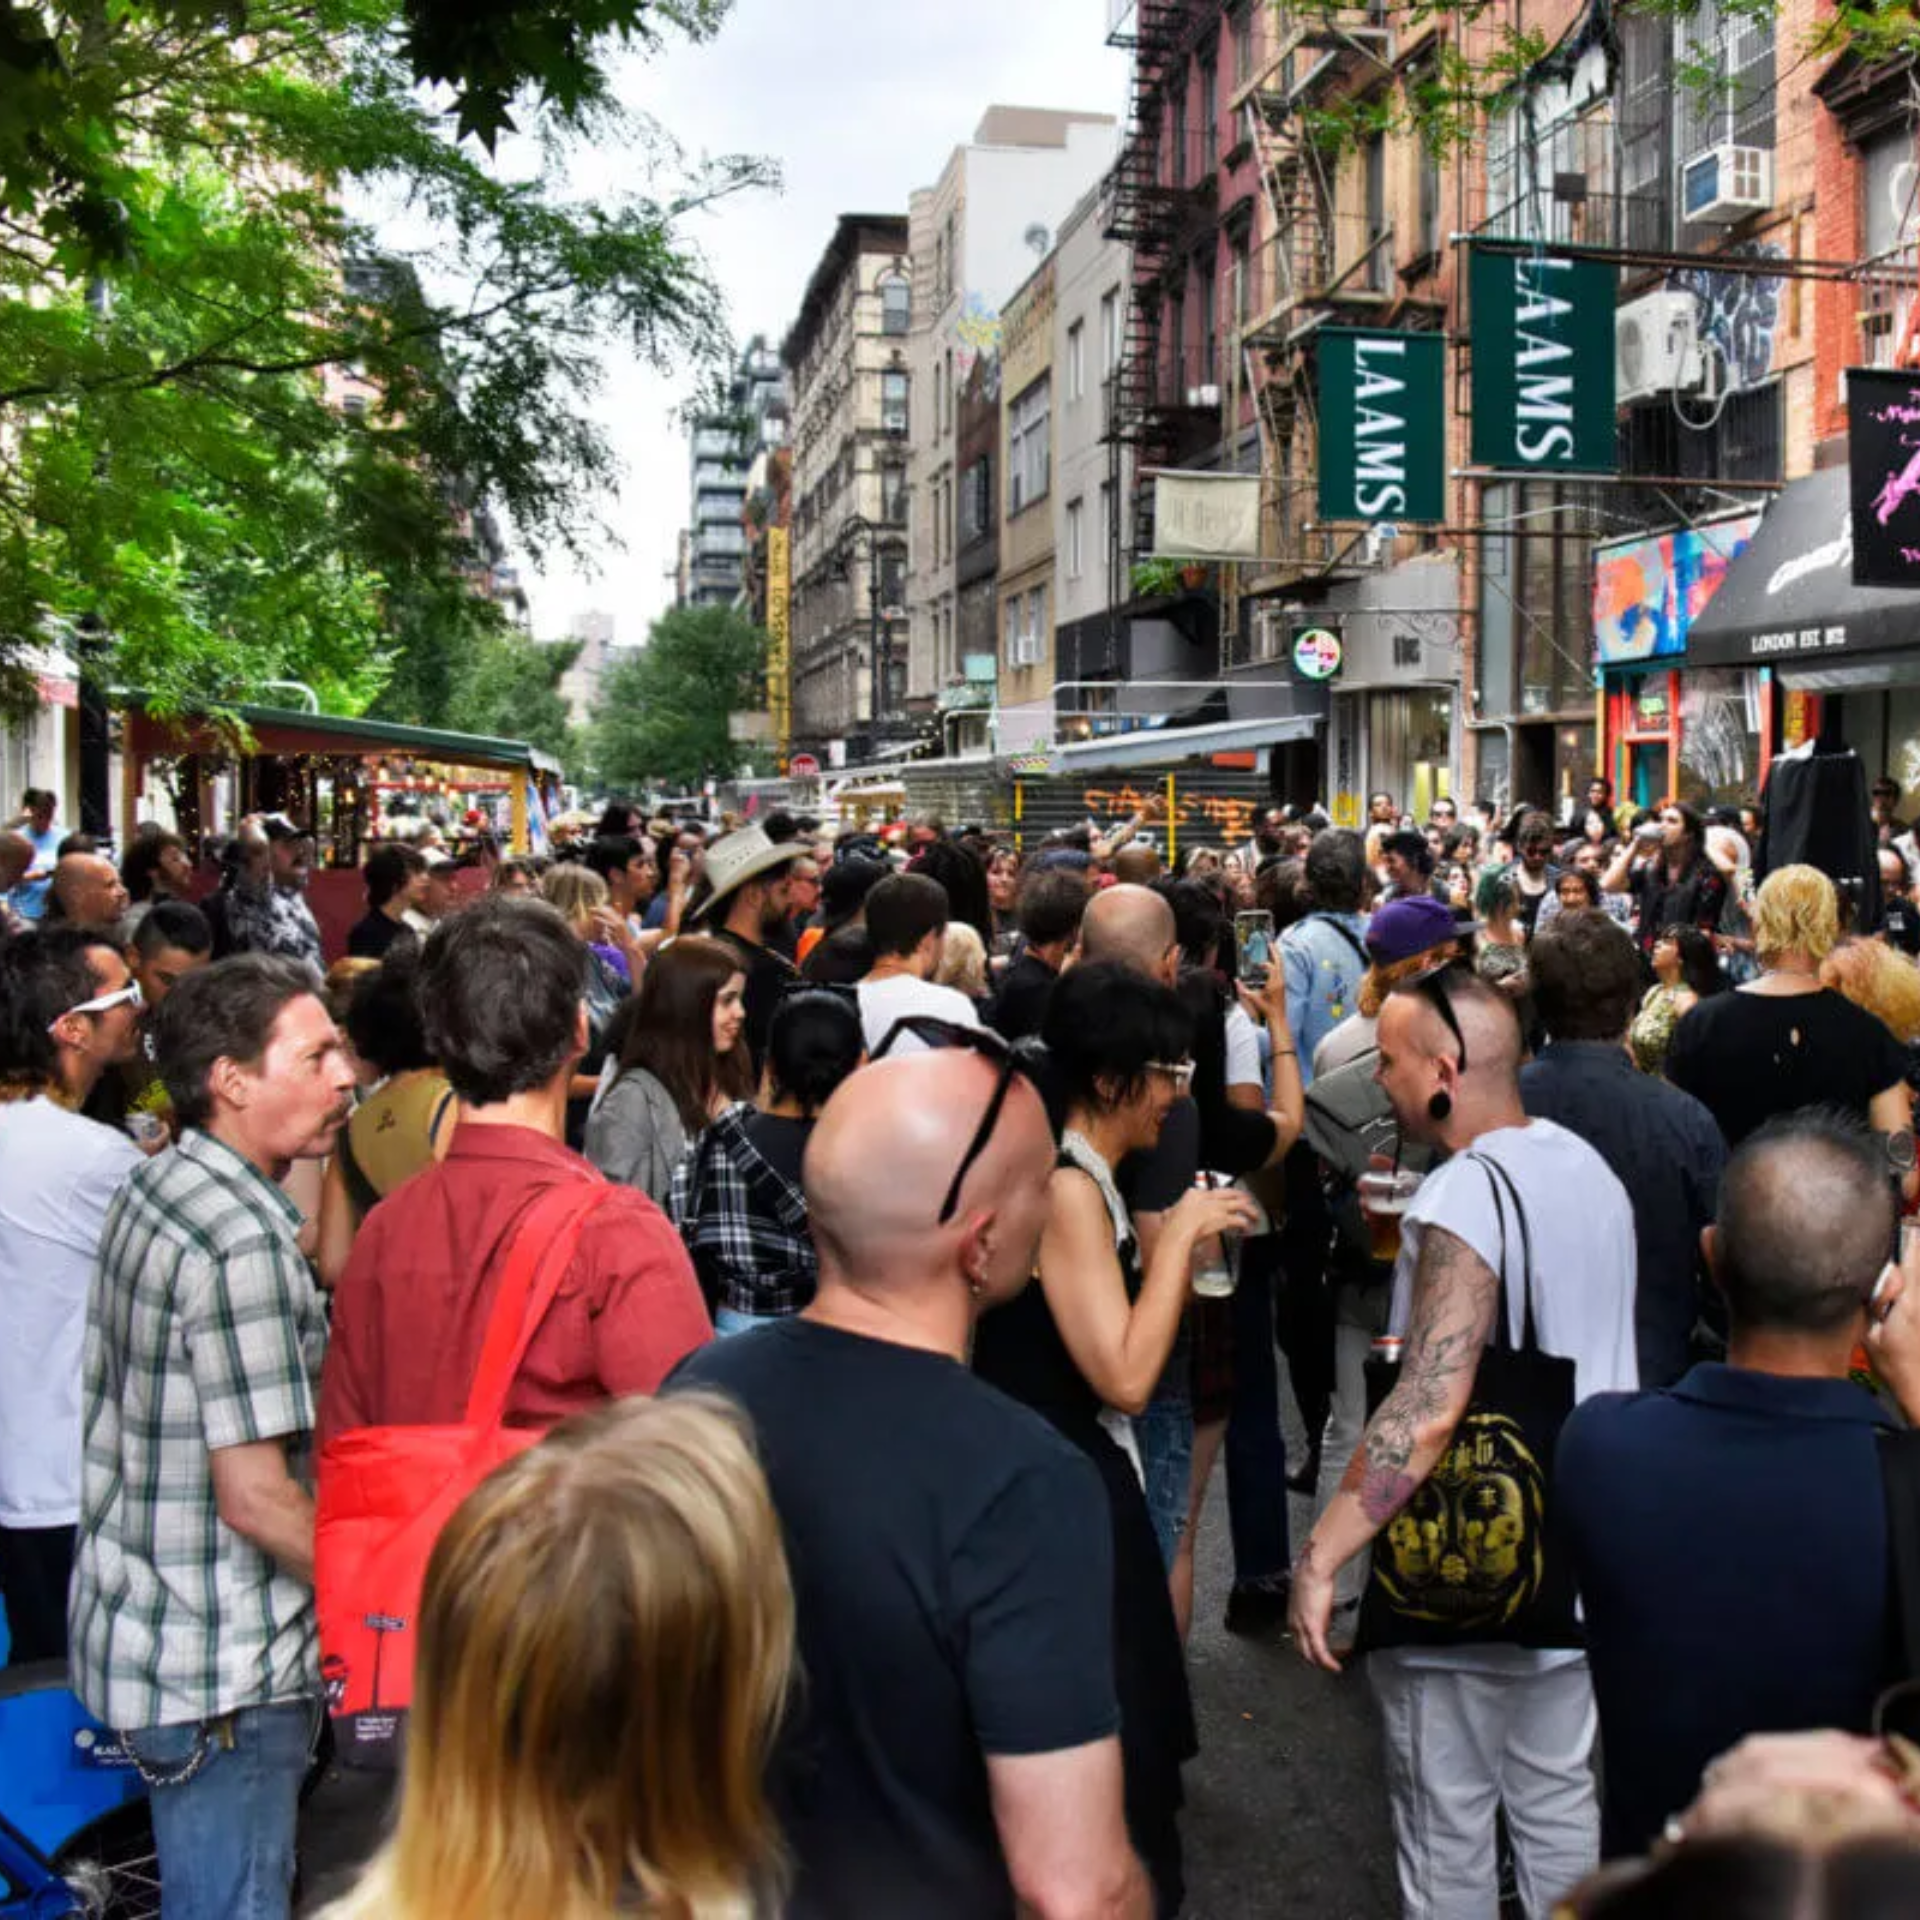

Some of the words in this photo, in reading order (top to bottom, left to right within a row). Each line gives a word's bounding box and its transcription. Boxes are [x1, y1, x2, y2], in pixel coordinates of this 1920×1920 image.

[1354, 338, 1406, 516] LAAMS
[1514, 256, 1574, 462] LAAMS
[1752, 632, 1796, 654] LONDON
